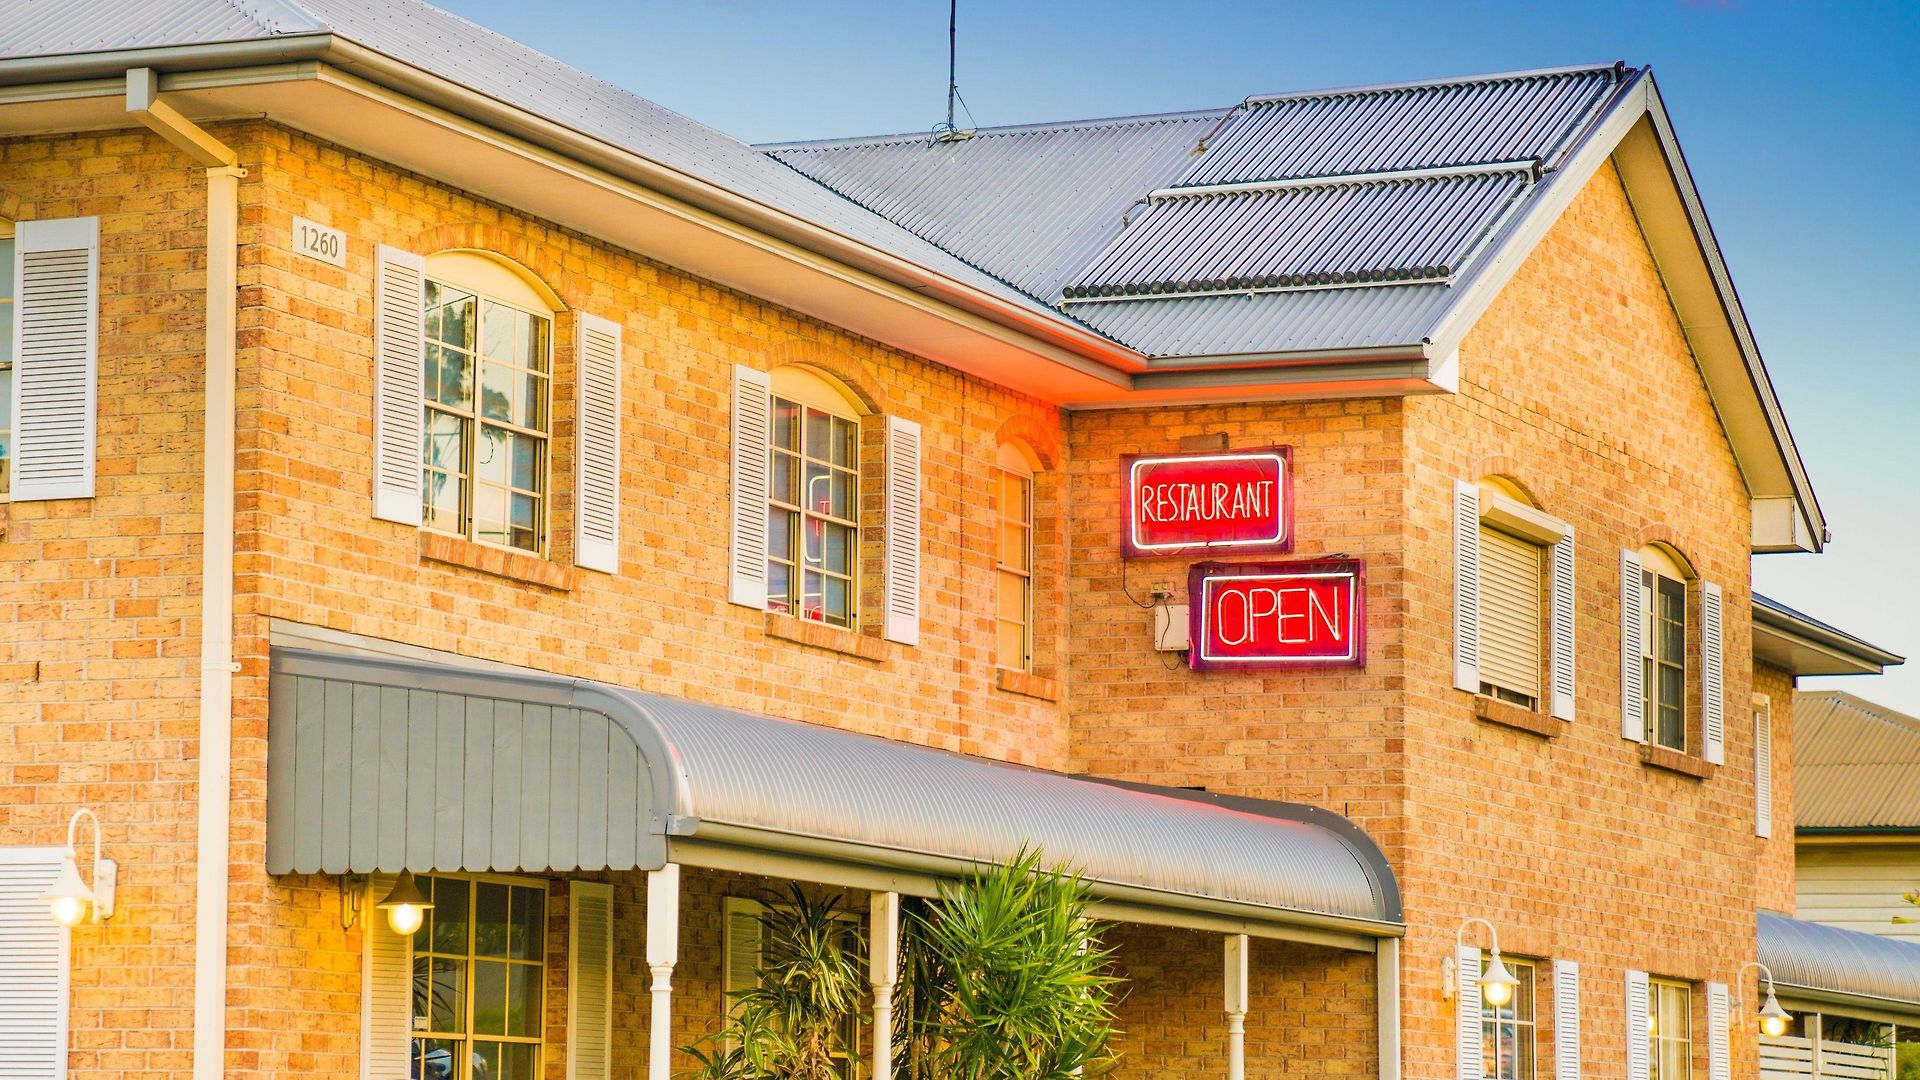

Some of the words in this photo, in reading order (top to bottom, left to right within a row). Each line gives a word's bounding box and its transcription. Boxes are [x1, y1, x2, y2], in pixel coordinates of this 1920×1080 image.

[301, 225, 338, 258] 1260
[1141, 480, 1274, 523] RESTAURANT
[1217, 586, 1341, 646] OPEN
